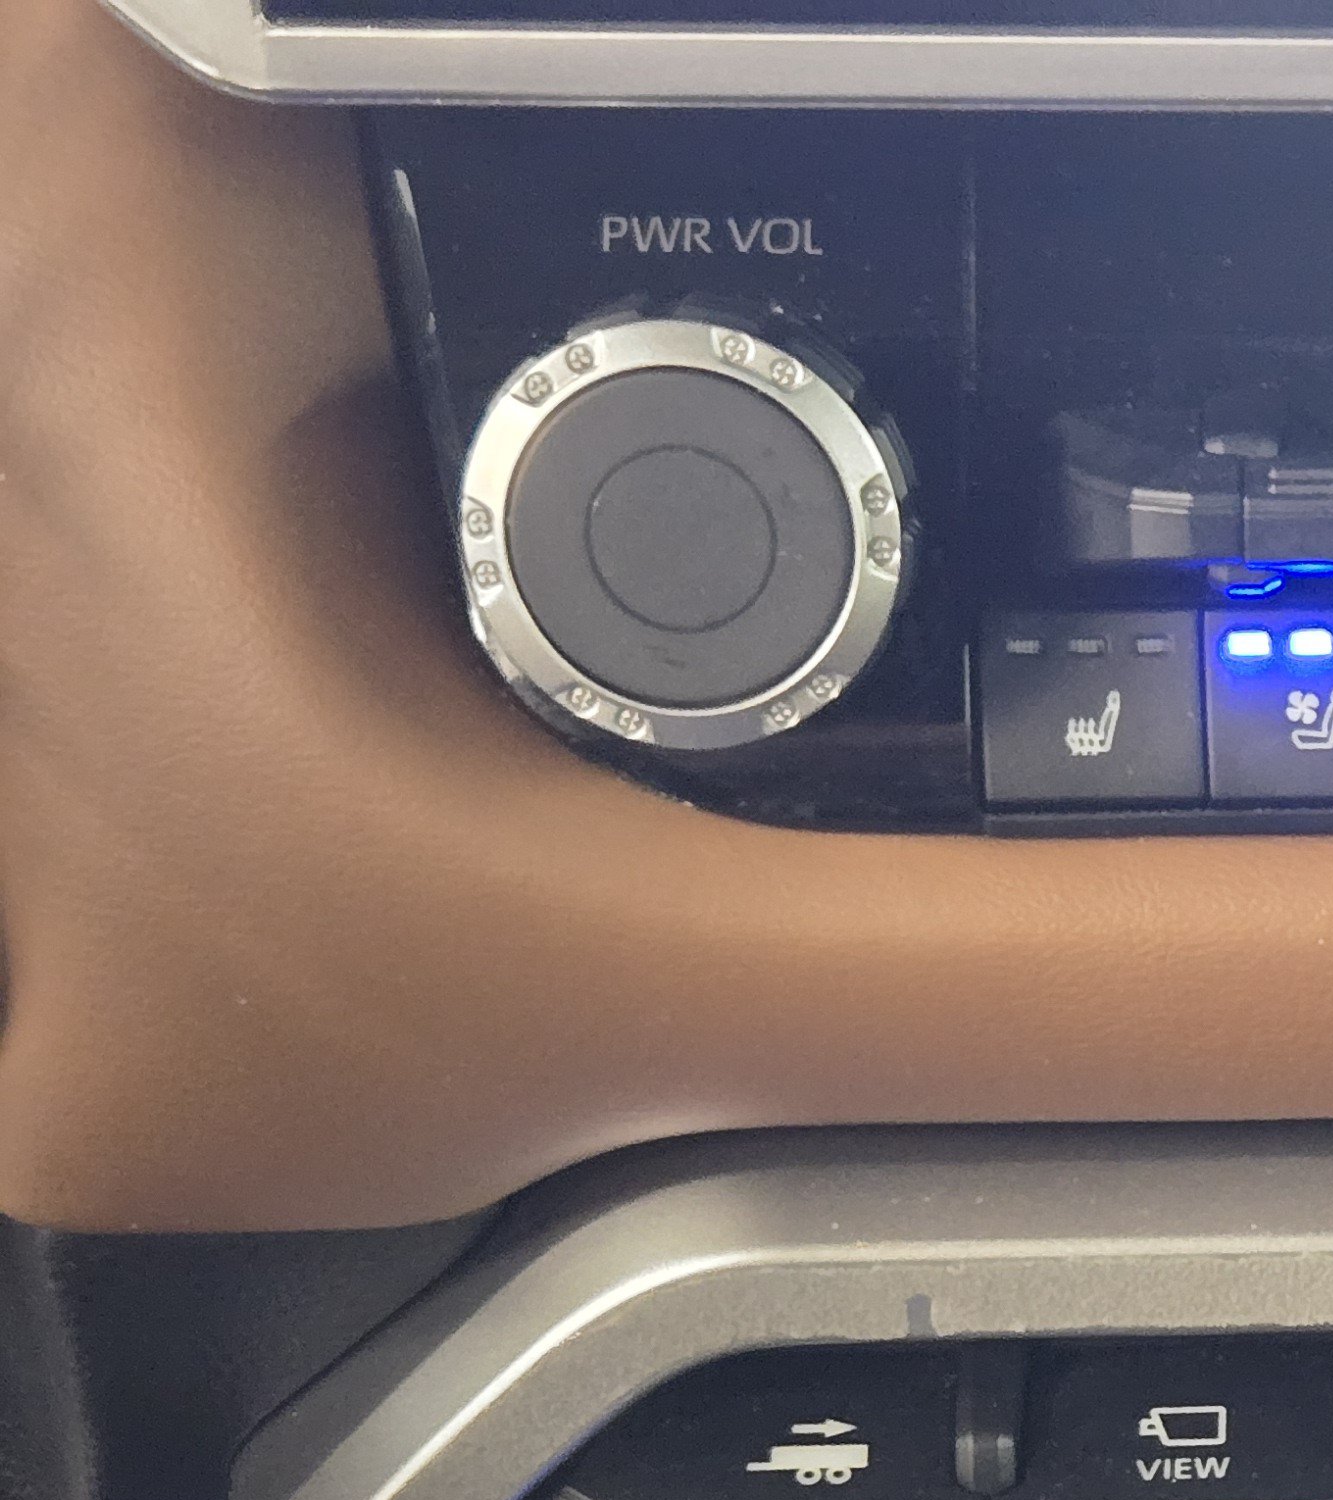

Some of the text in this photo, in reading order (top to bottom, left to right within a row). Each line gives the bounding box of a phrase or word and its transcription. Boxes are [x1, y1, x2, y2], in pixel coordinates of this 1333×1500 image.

[601, 216, 824, 256] PWR VOL
[1136, 1456, 1231, 1481] VIEW
